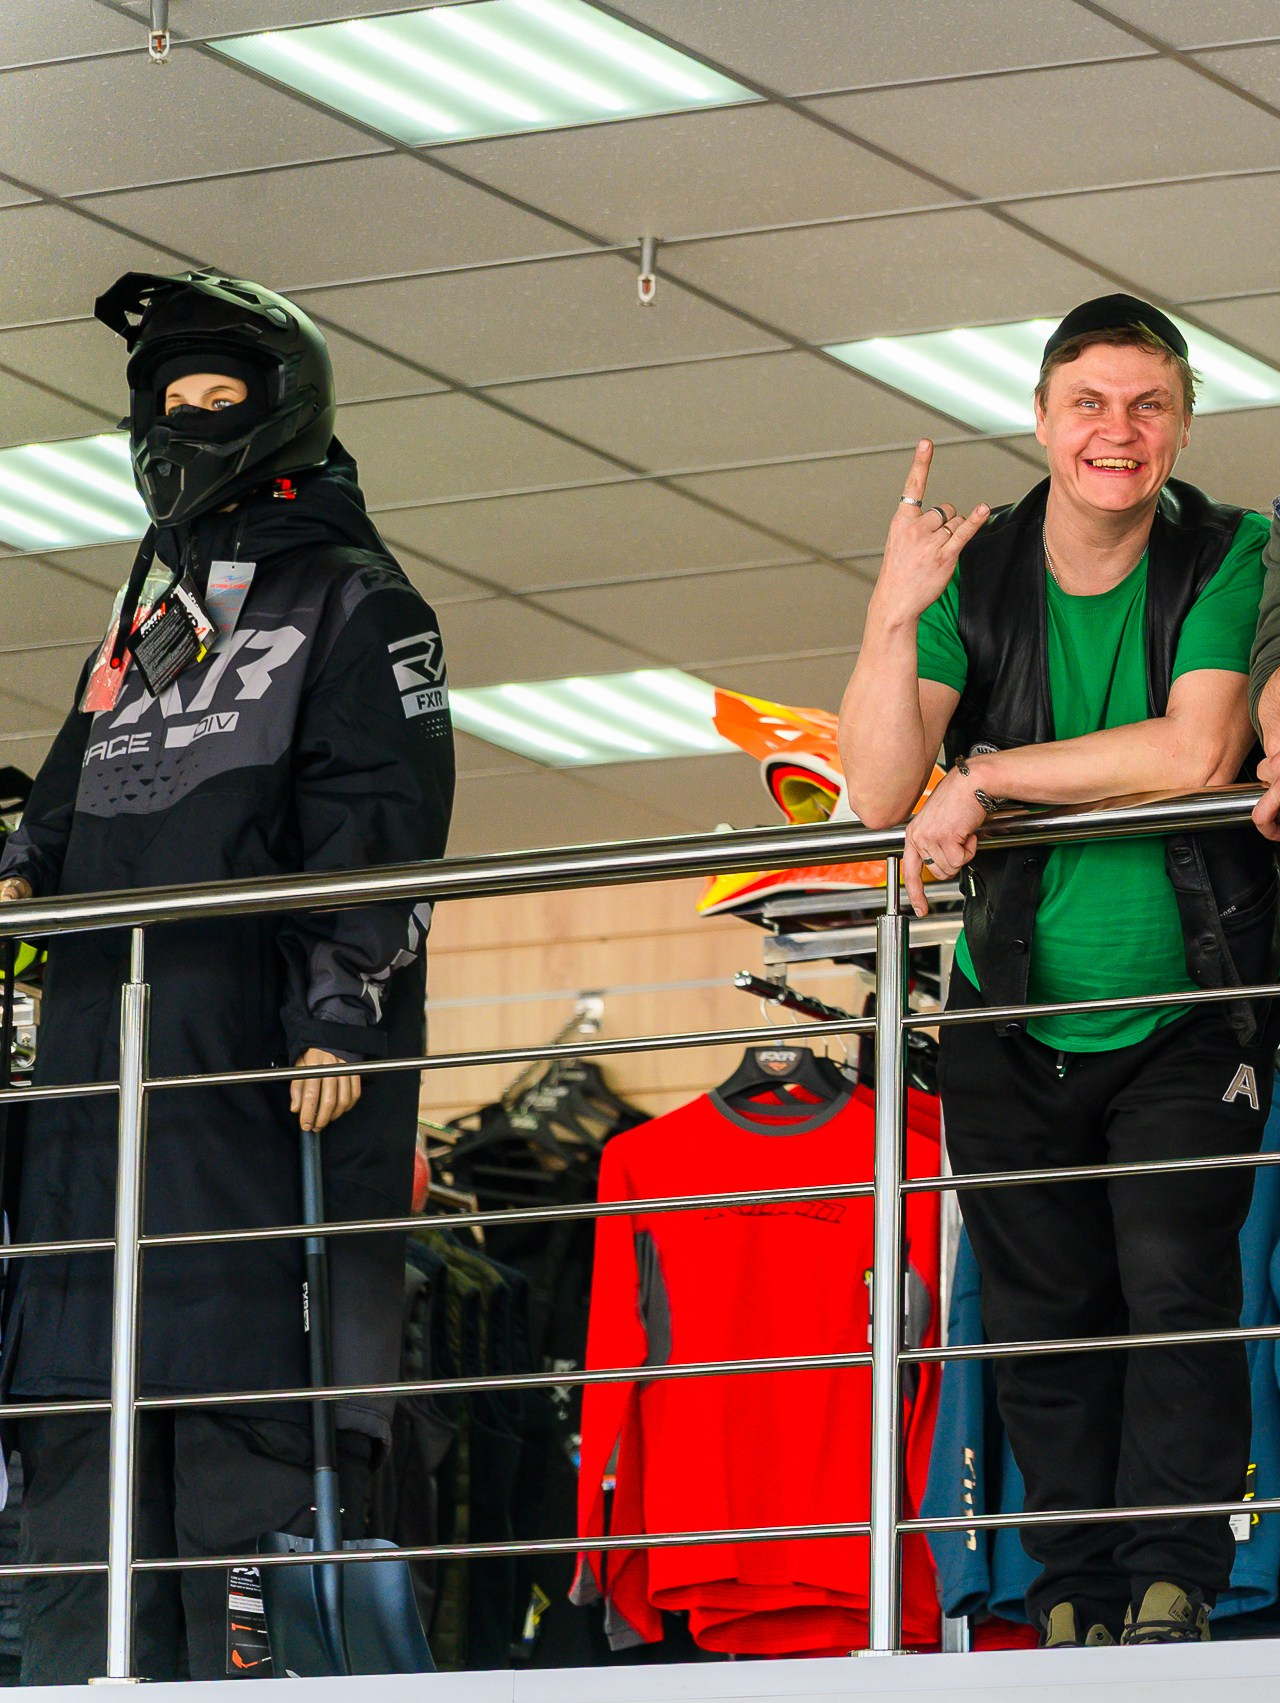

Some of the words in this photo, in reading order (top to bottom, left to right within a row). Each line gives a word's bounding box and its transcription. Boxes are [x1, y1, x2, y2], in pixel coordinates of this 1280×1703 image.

[416, 690, 443, 710] FXR
[193, 713, 236, 738] DIV
[1222, 1063, 1260, 1110] A
